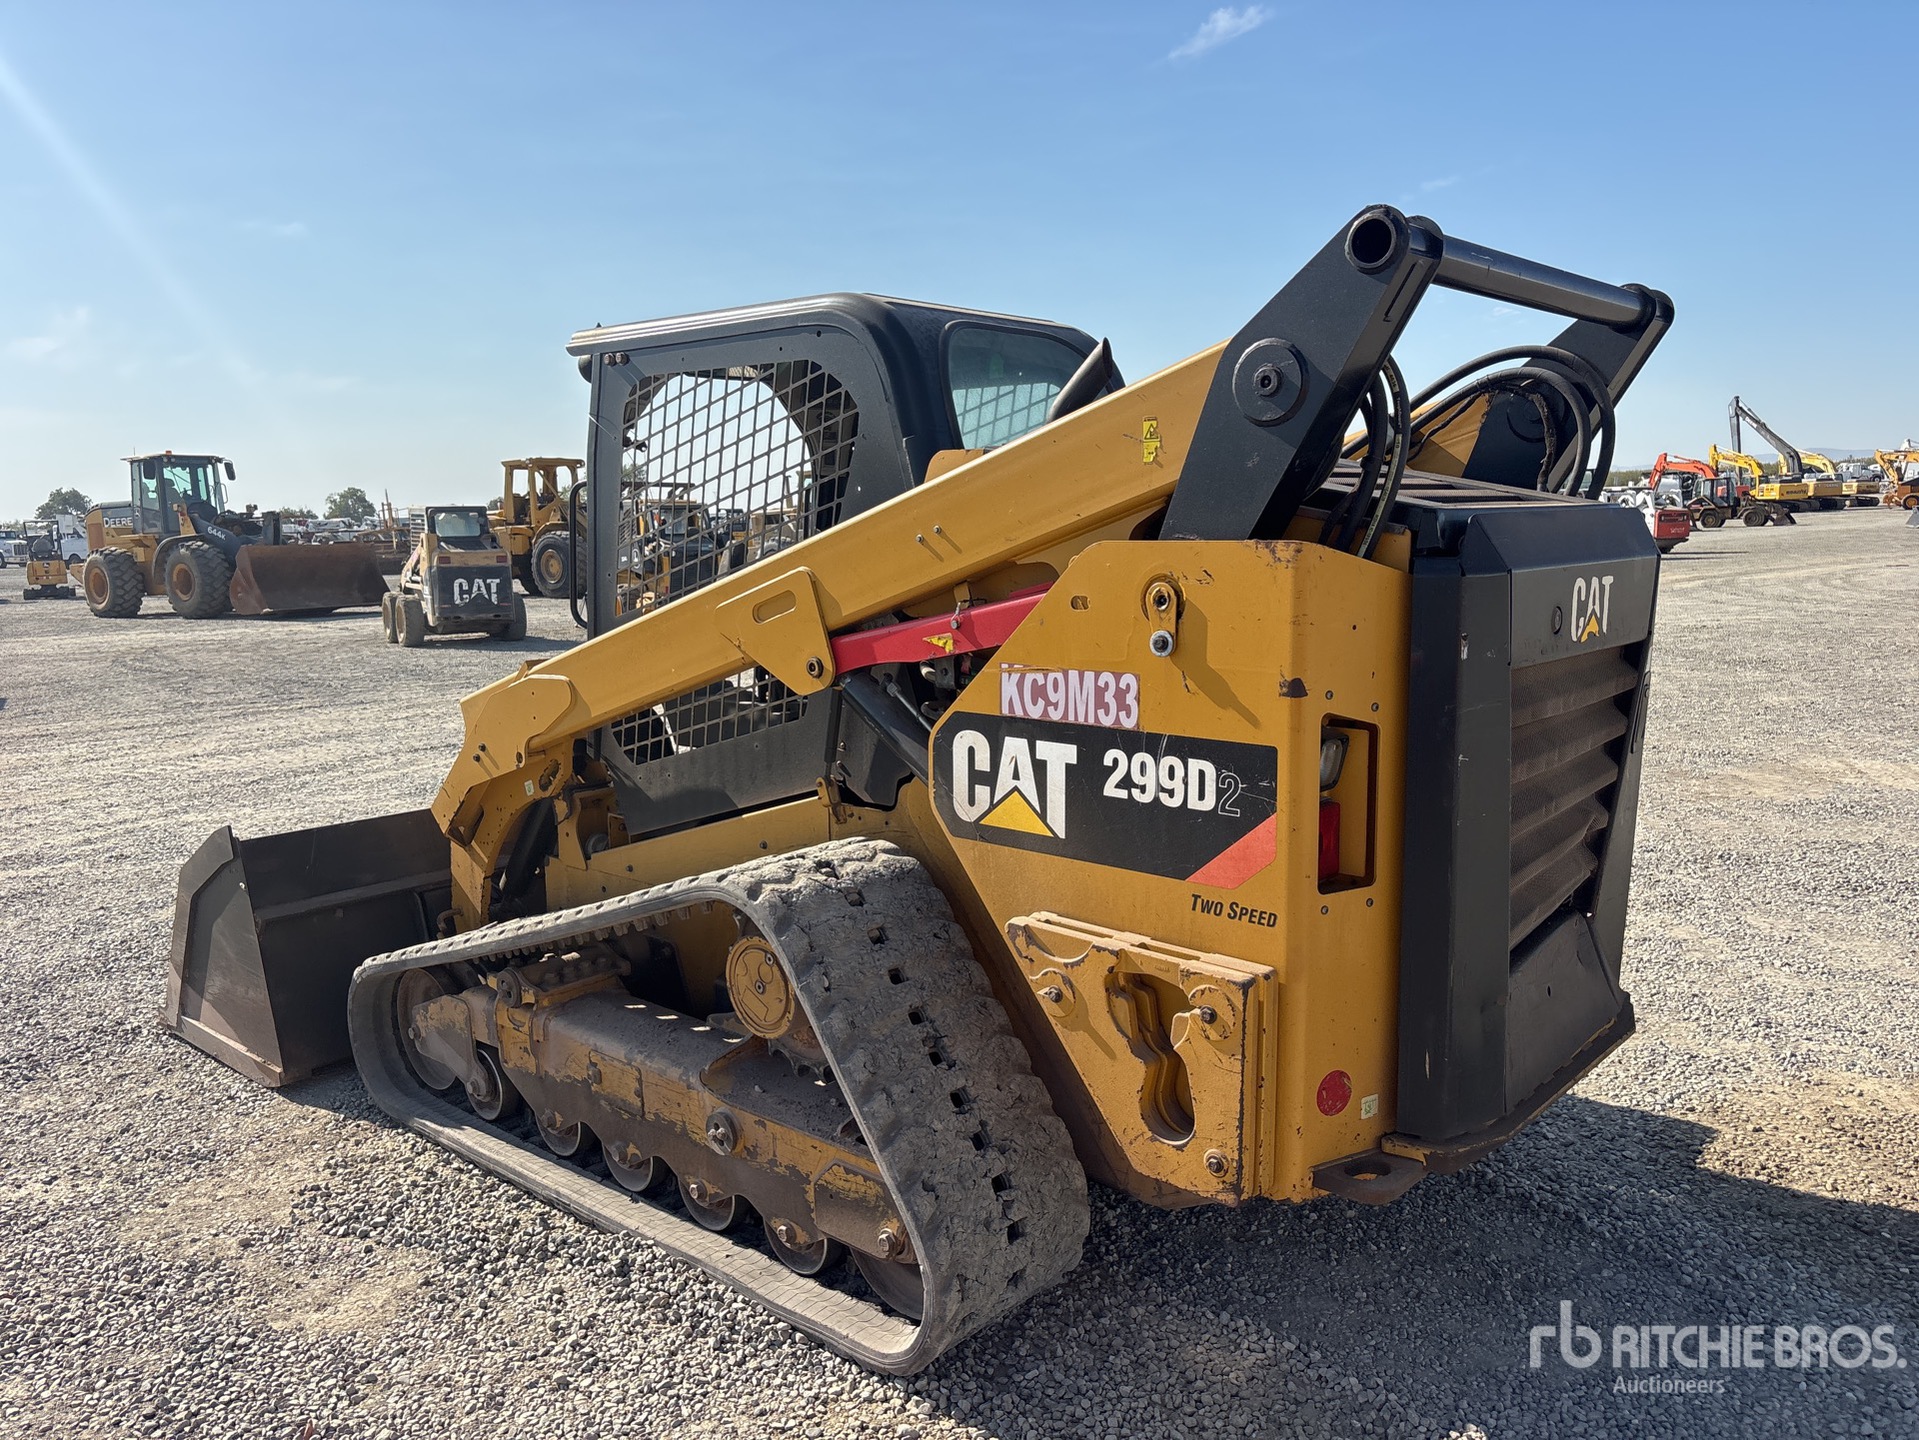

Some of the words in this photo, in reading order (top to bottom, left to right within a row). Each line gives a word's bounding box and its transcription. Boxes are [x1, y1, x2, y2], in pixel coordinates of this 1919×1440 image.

[103, 517, 133, 528] DEERE
[453, 578, 500, 607] CAT
[1571, 575, 1614, 642] CAT
[1001, 666, 1138, 729] KC9M33
[952, 730, 1077, 839] CAT
